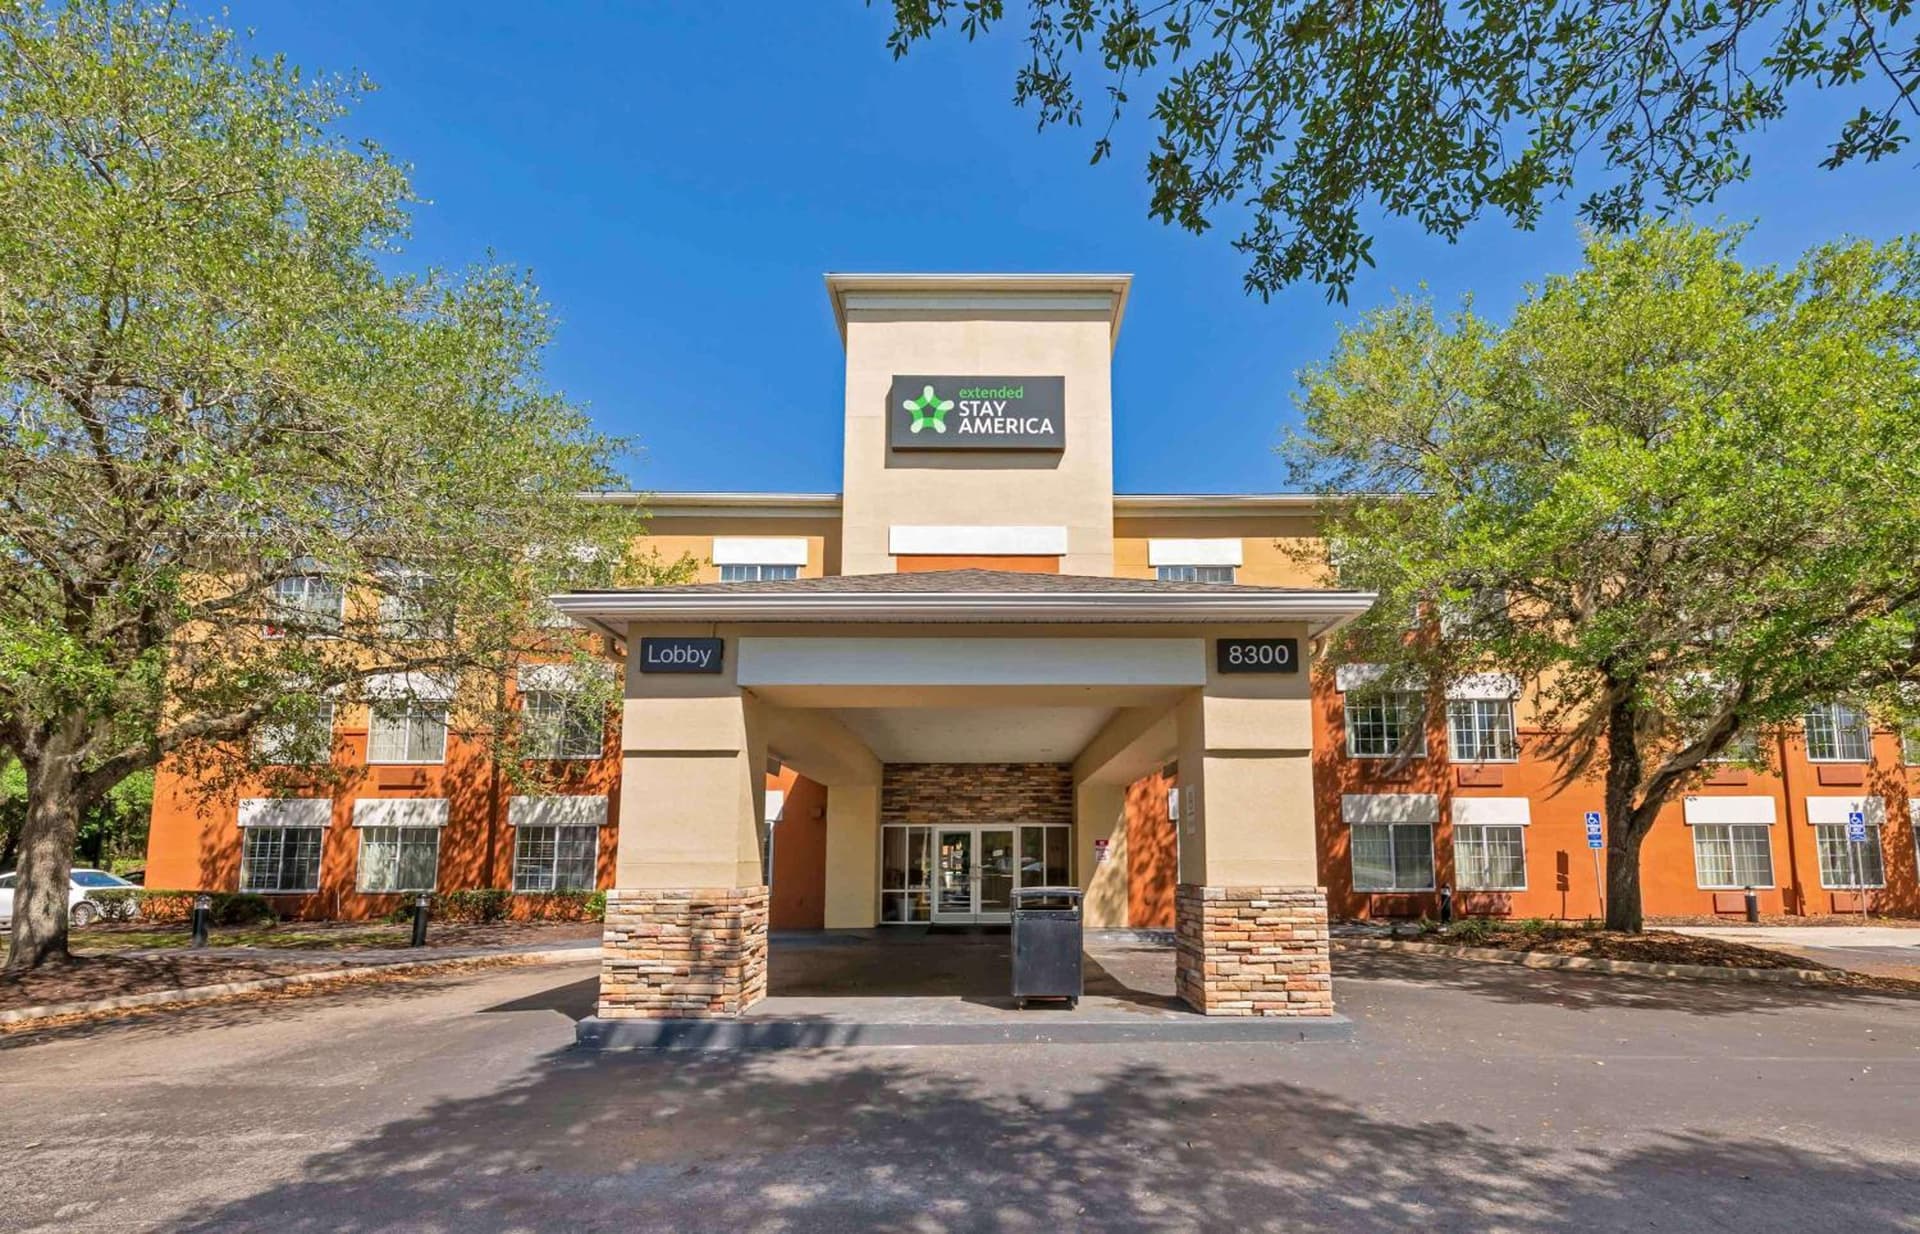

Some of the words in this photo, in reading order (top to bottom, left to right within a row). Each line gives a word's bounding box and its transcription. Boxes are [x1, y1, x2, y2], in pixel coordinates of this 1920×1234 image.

[959, 386, 1024, 399] extended
[959, 401, 1007, 417] STAY
[958, 418, 1054, 434] AMERICA
[648, 644, 712, 667] Lobby
[1229, 645, 1289, 664] 8300
